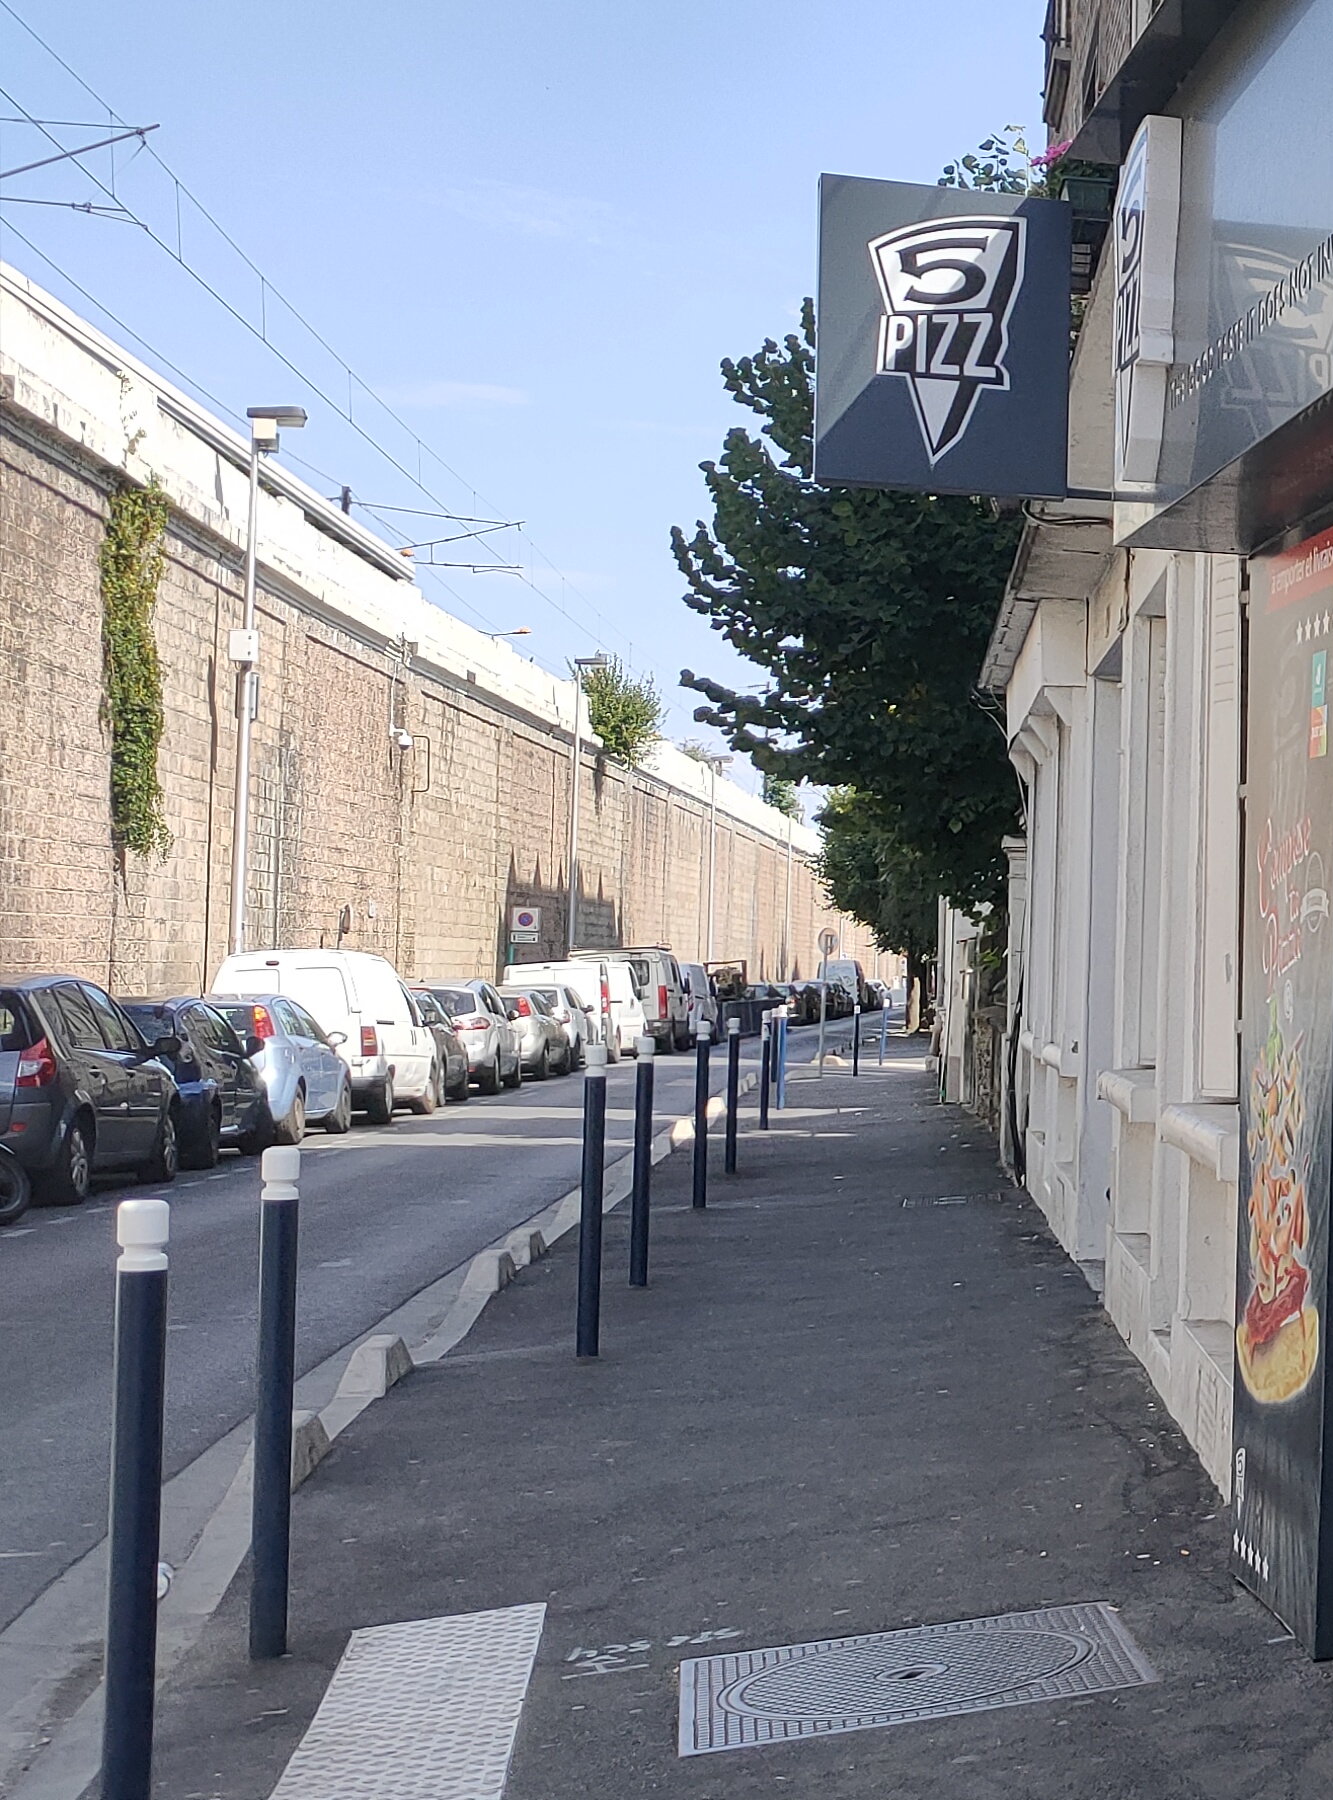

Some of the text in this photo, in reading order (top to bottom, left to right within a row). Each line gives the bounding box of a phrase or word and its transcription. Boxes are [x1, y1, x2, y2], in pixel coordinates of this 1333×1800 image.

[1121, 157, 1142, 274] 5
[895, 236, 990, 305] 5
[1116, 262, 1140, 368] PIZZ
[884, 311, 998, 379] PIZZ
[1188, 347, 1213, 396] GOOD
[1217, 318, 1243, 369] TASTE
[1246, 306, 1255, 344] IT
[1258, 279, 1285, 335] DOES
[1289, 253, 1314, 308] NOT
